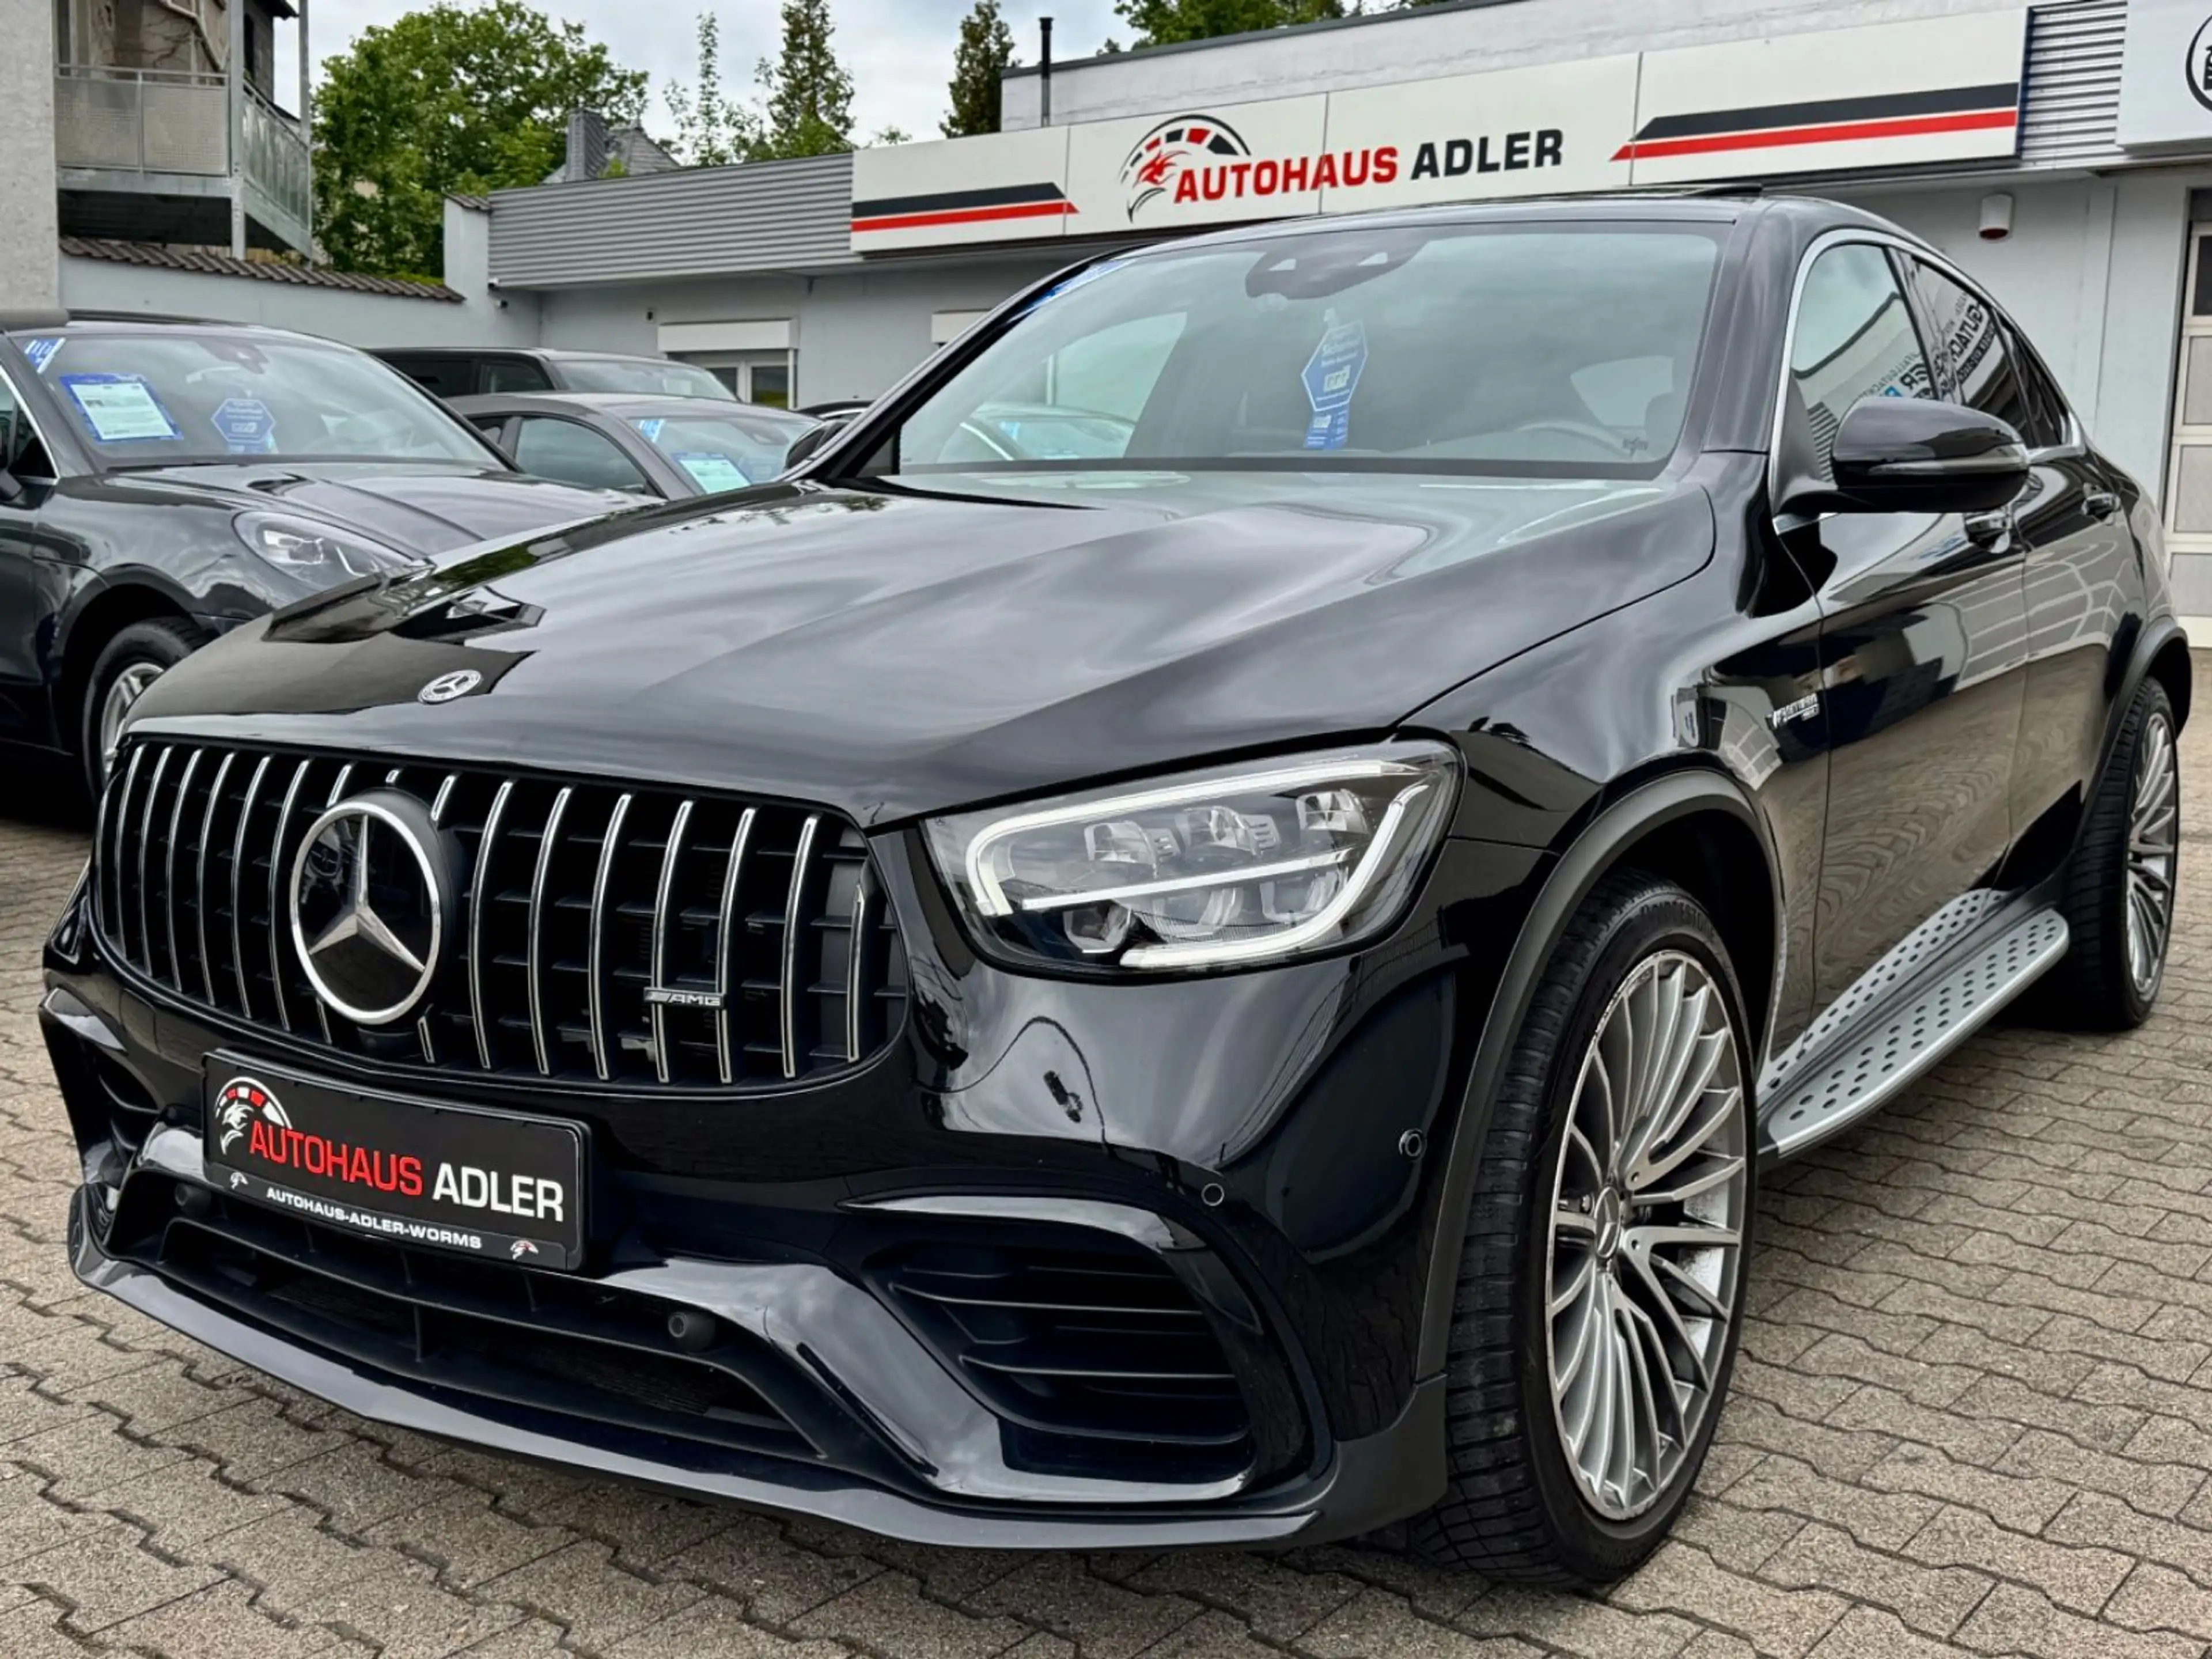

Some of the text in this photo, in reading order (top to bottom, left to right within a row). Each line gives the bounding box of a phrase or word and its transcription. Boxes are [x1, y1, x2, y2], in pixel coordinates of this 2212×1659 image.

[1174, 128, 1563, 203] AUTOHAUS ADLER
[668, 994, 721, 1006] AMG
[249, 1120, 564, 1222] AUTOHAUS ADLER
[266, 1186, 482, 1249] AUTOHAUS-ADLER-WORMS
